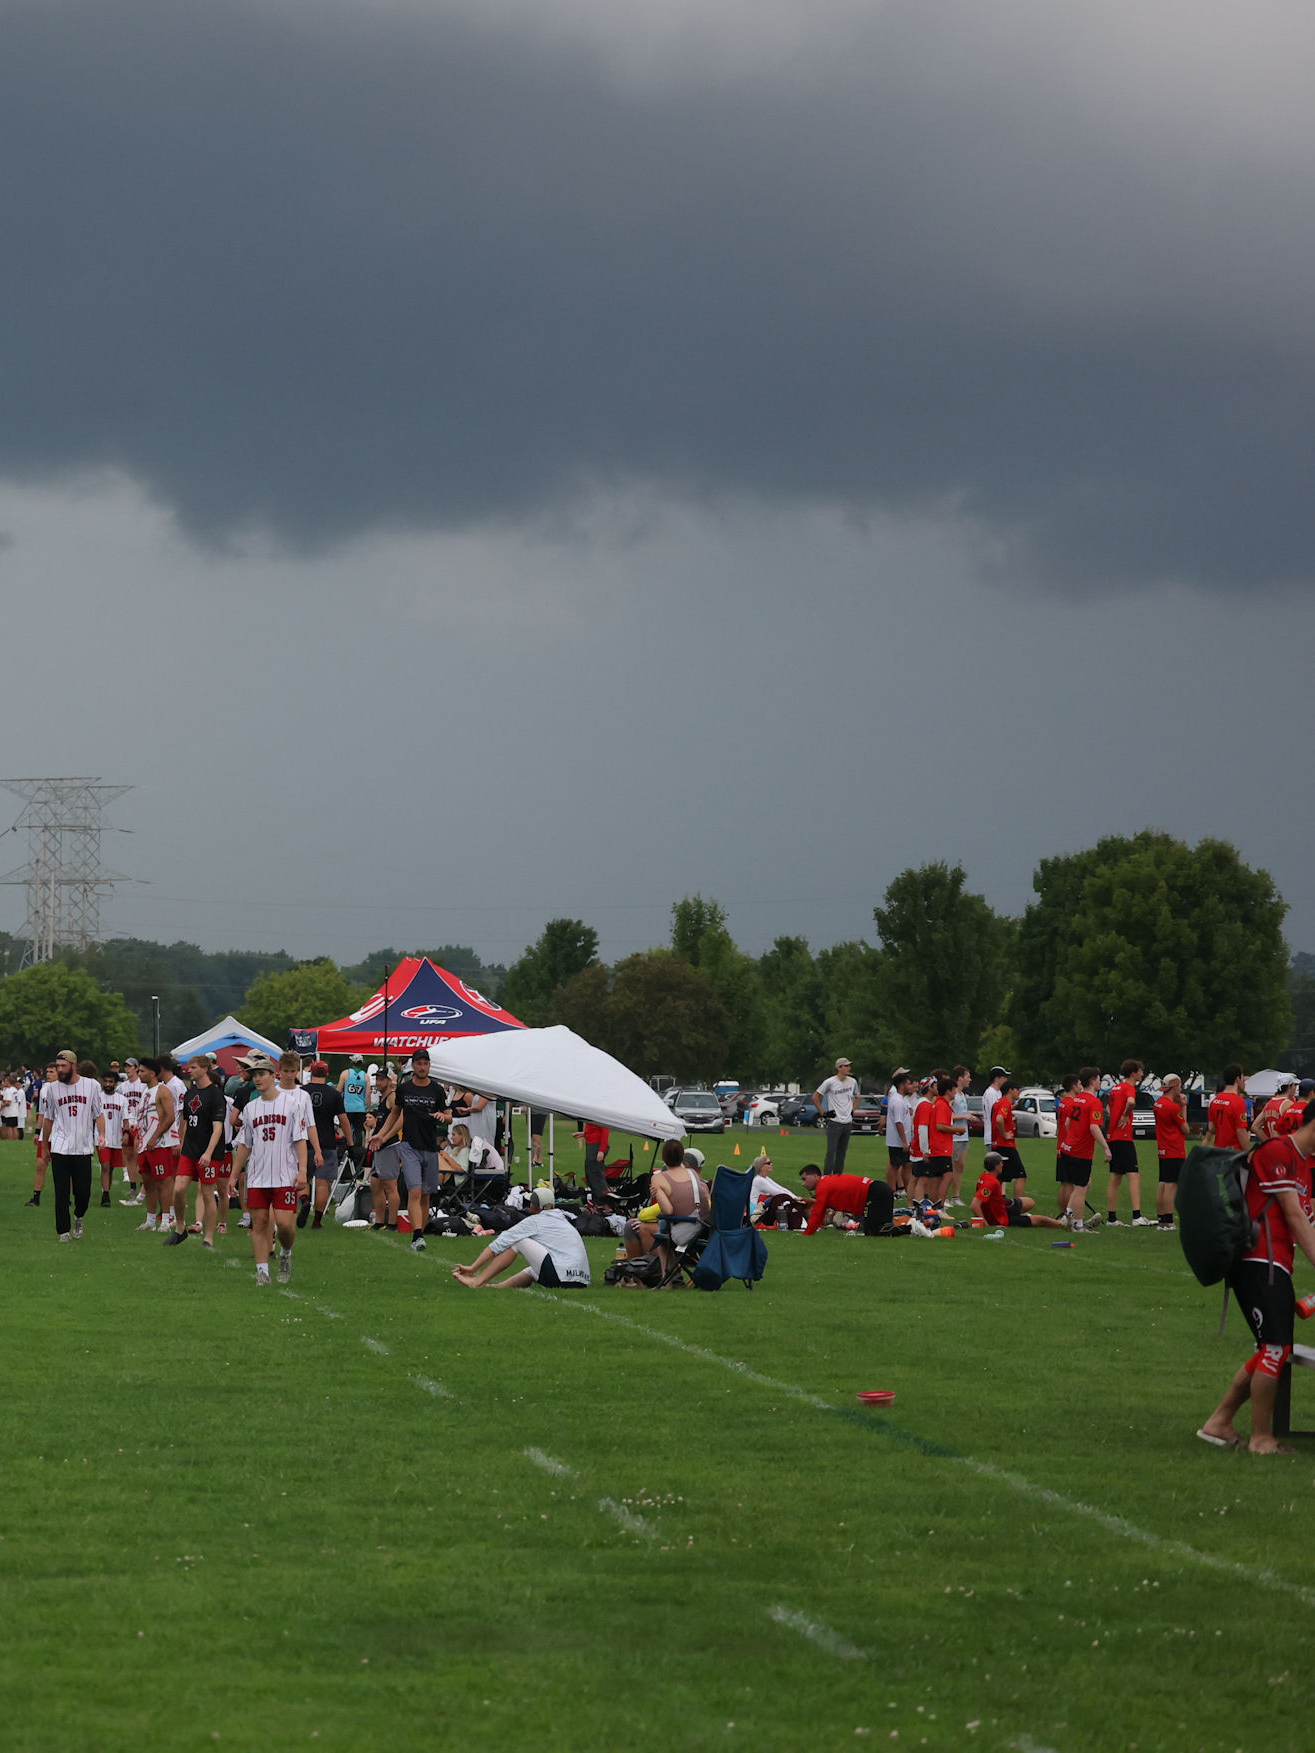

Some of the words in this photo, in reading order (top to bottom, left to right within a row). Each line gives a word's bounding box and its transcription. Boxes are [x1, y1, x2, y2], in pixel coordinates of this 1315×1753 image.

[348, 1084, 364, 1094] 67
[58, 1095, 87, 1107] MADISON
[68, 1106, 77, 1117] 15
[189, 1115, 198, 1127] 29
[252, 1114, 287, 1129] MADISON
[262, 1127, 276, 1142] 35
[155, 1165, 165, 1175] 19
[205, 1167, 216, 1179] 29
[220, 1163, 231, 1174] 44
[285, 1191, 296, 1204] 35
